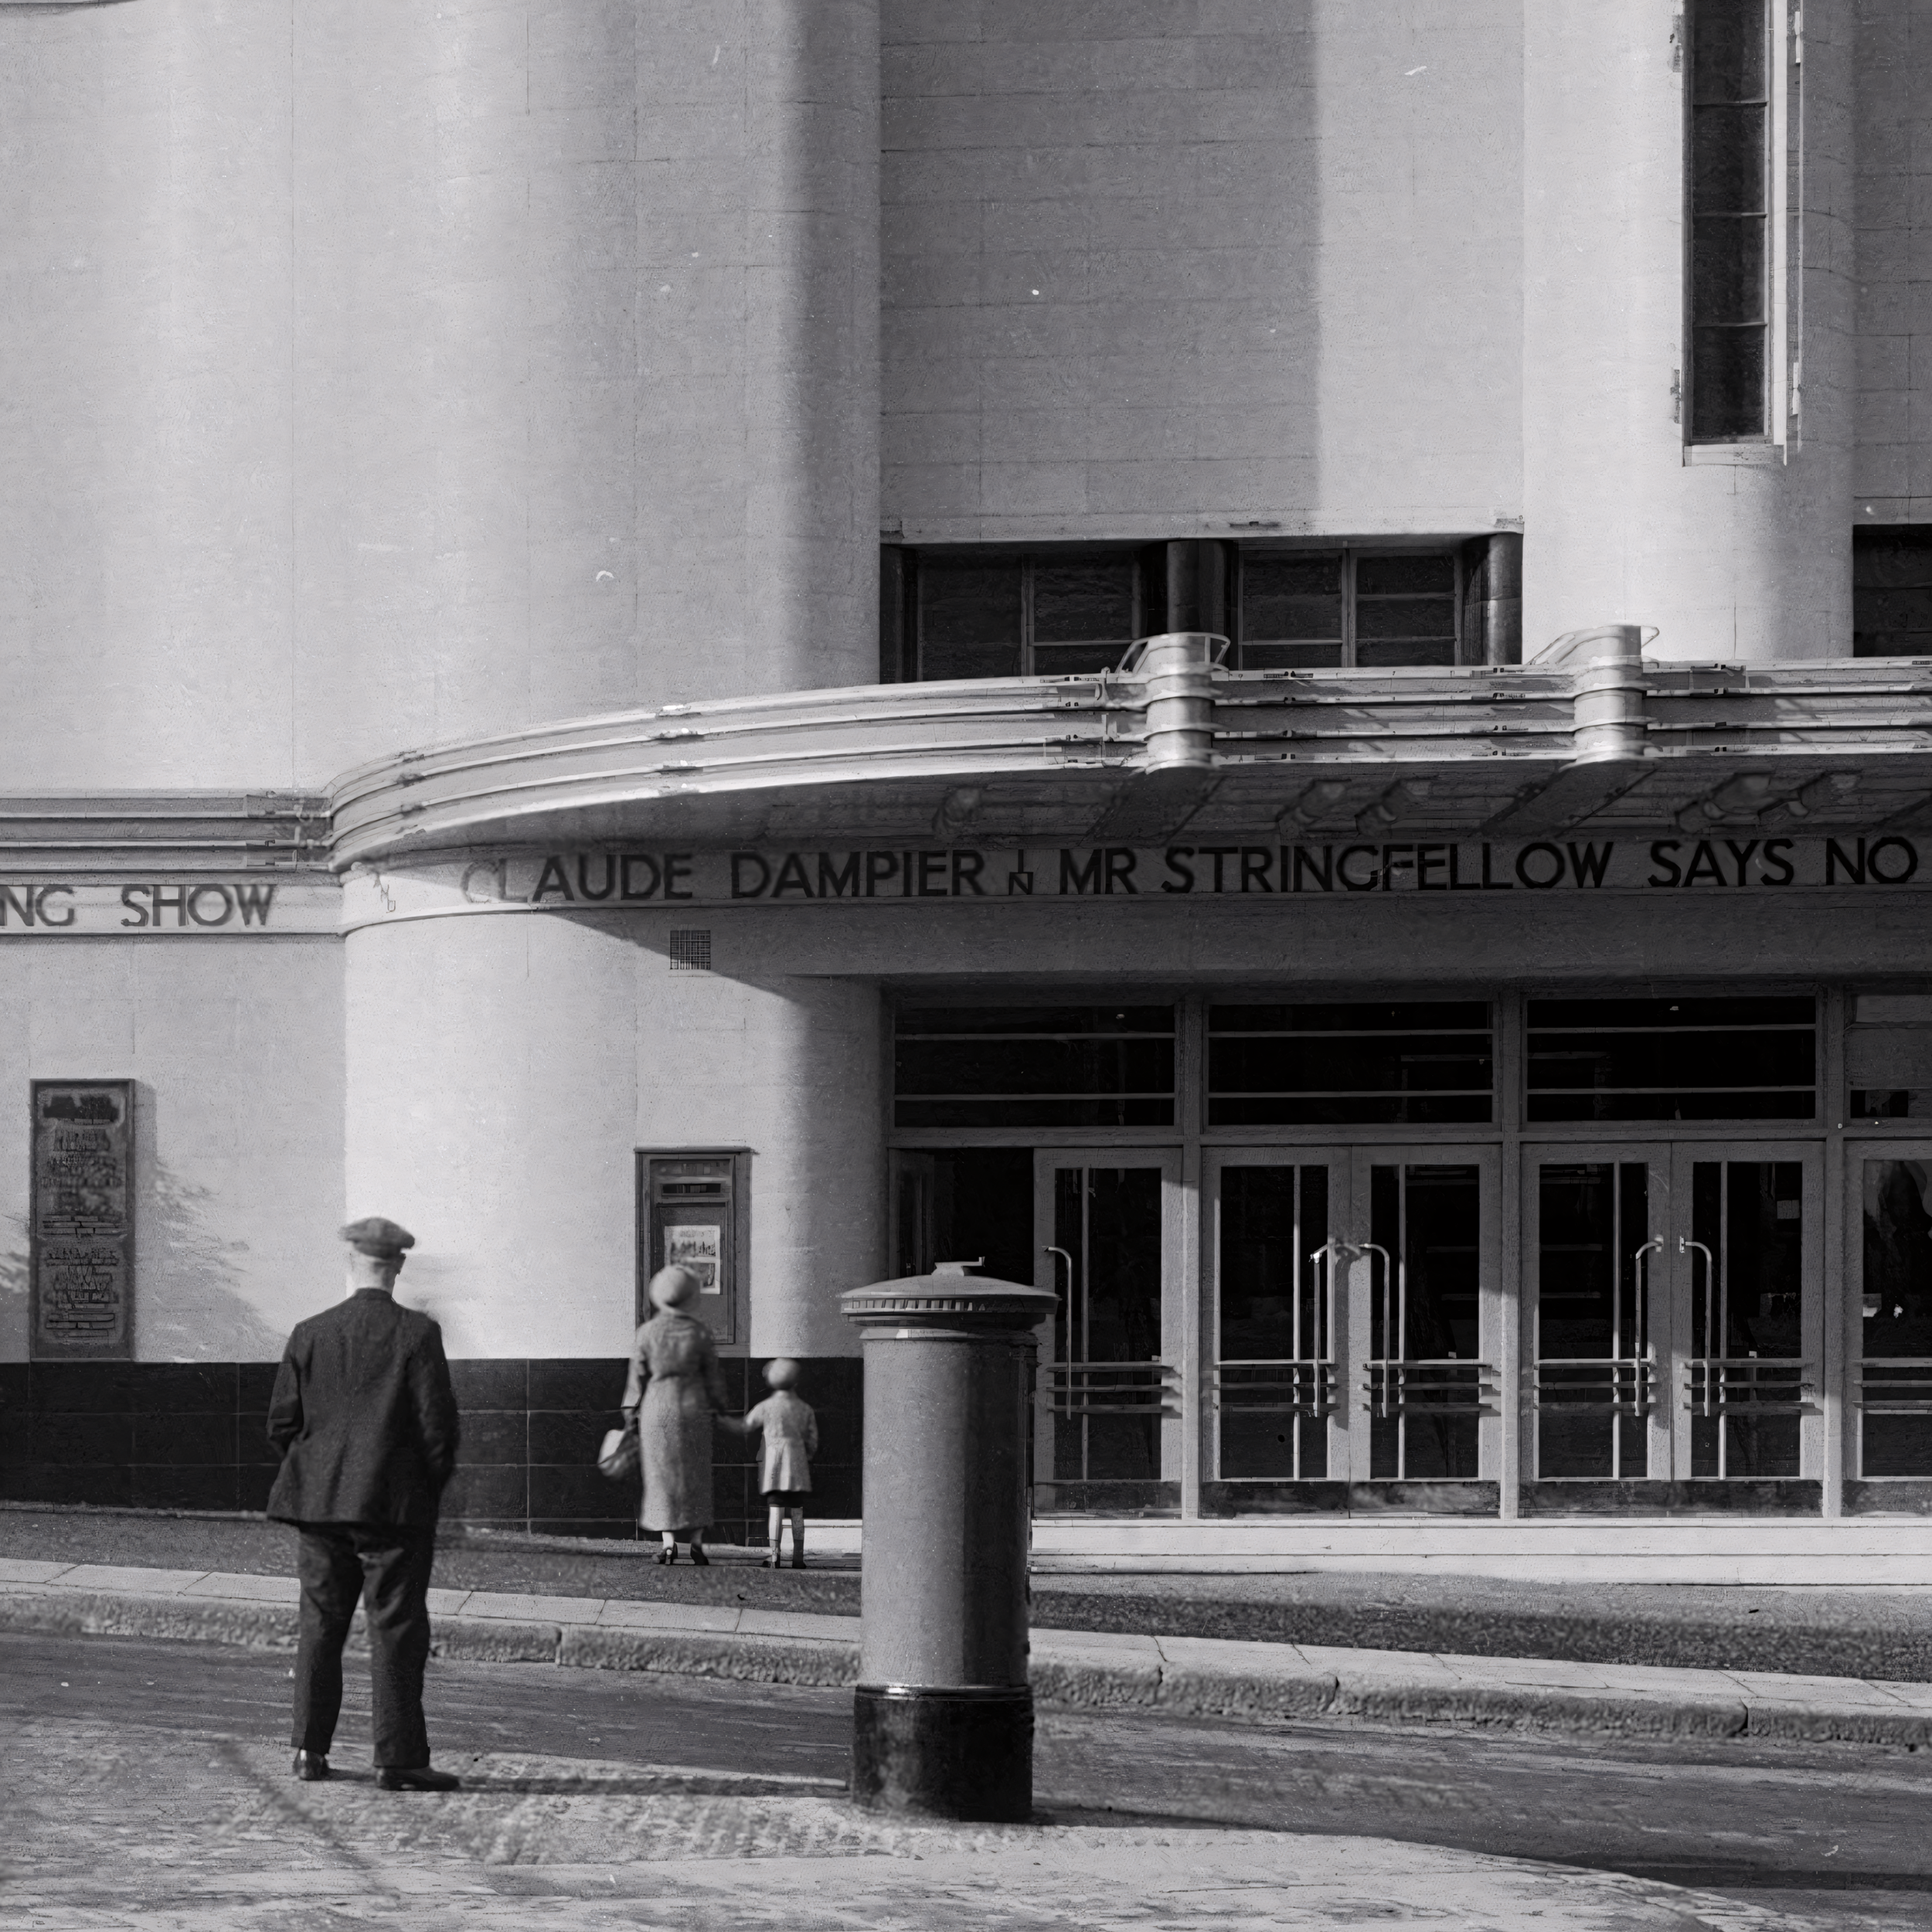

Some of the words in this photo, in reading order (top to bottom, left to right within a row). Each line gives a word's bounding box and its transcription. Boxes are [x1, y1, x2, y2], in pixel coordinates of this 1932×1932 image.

[461, 853, 693, 903] CLAUDE
[731, 850, 986, 898] DAMPIER
[1060, 849, 1138, 895] MR
[1161, 842, 1614, 893] STRINGFELLOW
[1648, 838, 1794, 887] SAYS
[1825, 837, 1918, 885] NO
[121, 884, 276, 927] SHOW
